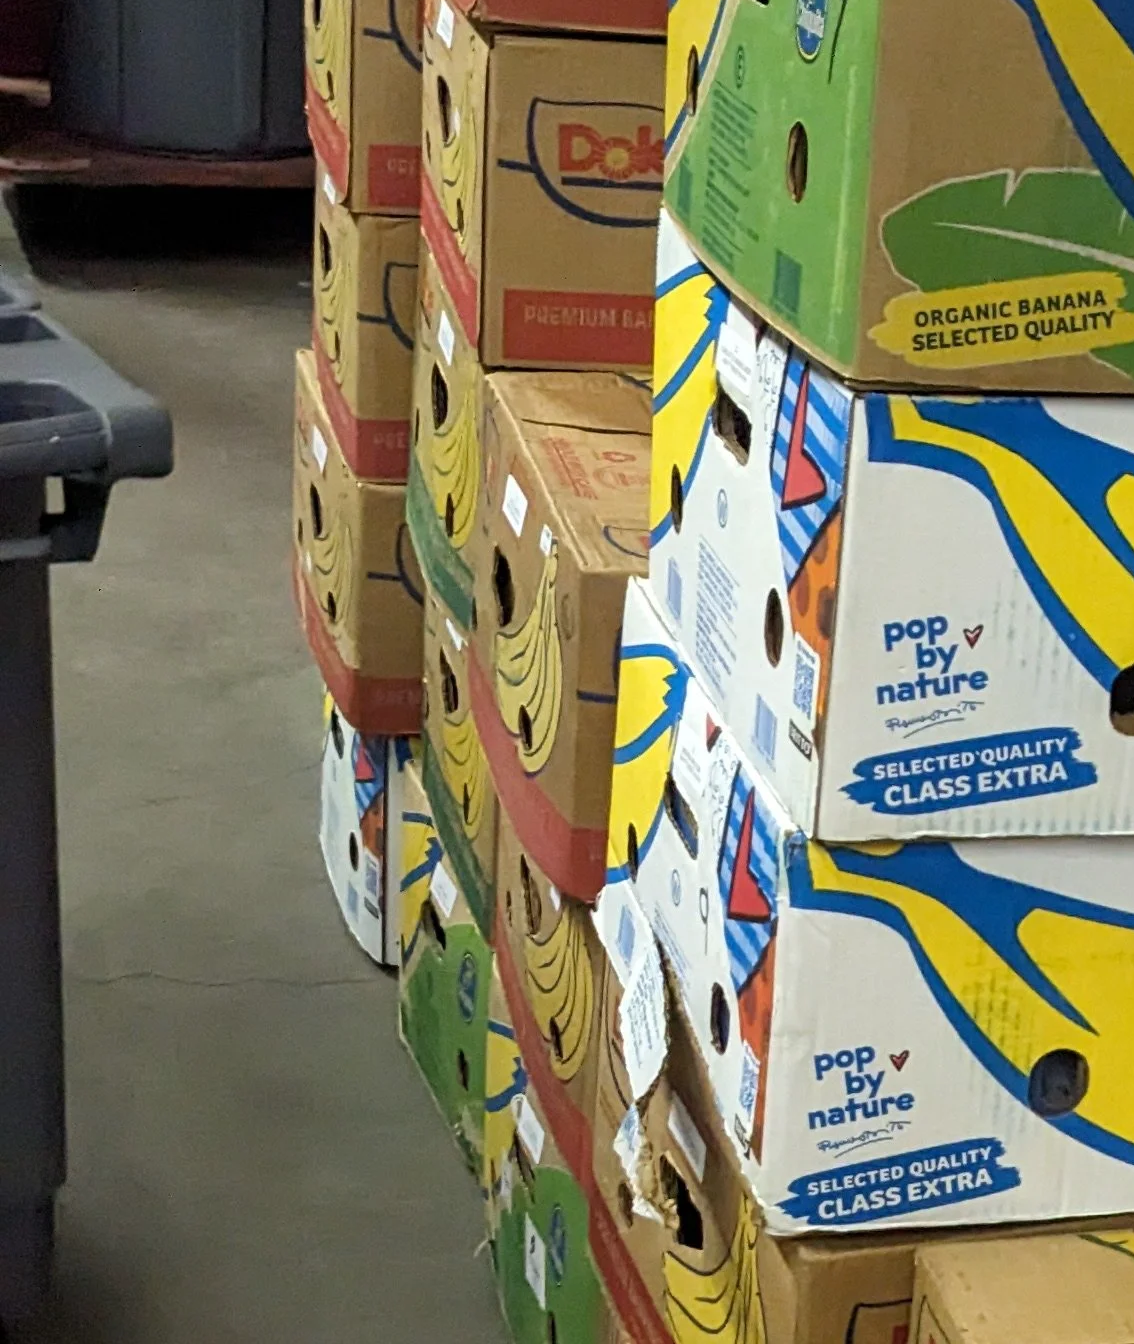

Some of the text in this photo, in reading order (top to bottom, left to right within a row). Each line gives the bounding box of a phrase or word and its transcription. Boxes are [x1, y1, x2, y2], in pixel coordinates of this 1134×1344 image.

[523, 304, 616, 328] PREMIUM
[914, 289, 1107, 328] ORGANIC BANANA
[912, 310, 1115, 351] SELECTED QUALITY
[884, 615, 948, 652] pop
[915, 642, 958, 674] by
[876, 670, 989, 705] nature
[874, 737, 1068, 780] SELECTED QUALITY
[884, 761, 1068, 808] CLASS EXTRA
[813, 1046, 876, 1080] pop
[845, 1070, 885, 1098] by
[808, 1092, 915, 1130] nature
[807, 1146, 992, 1196] SELECTED QUALITY
[818, 1168, 993, 1220] CLASS EXTRA
